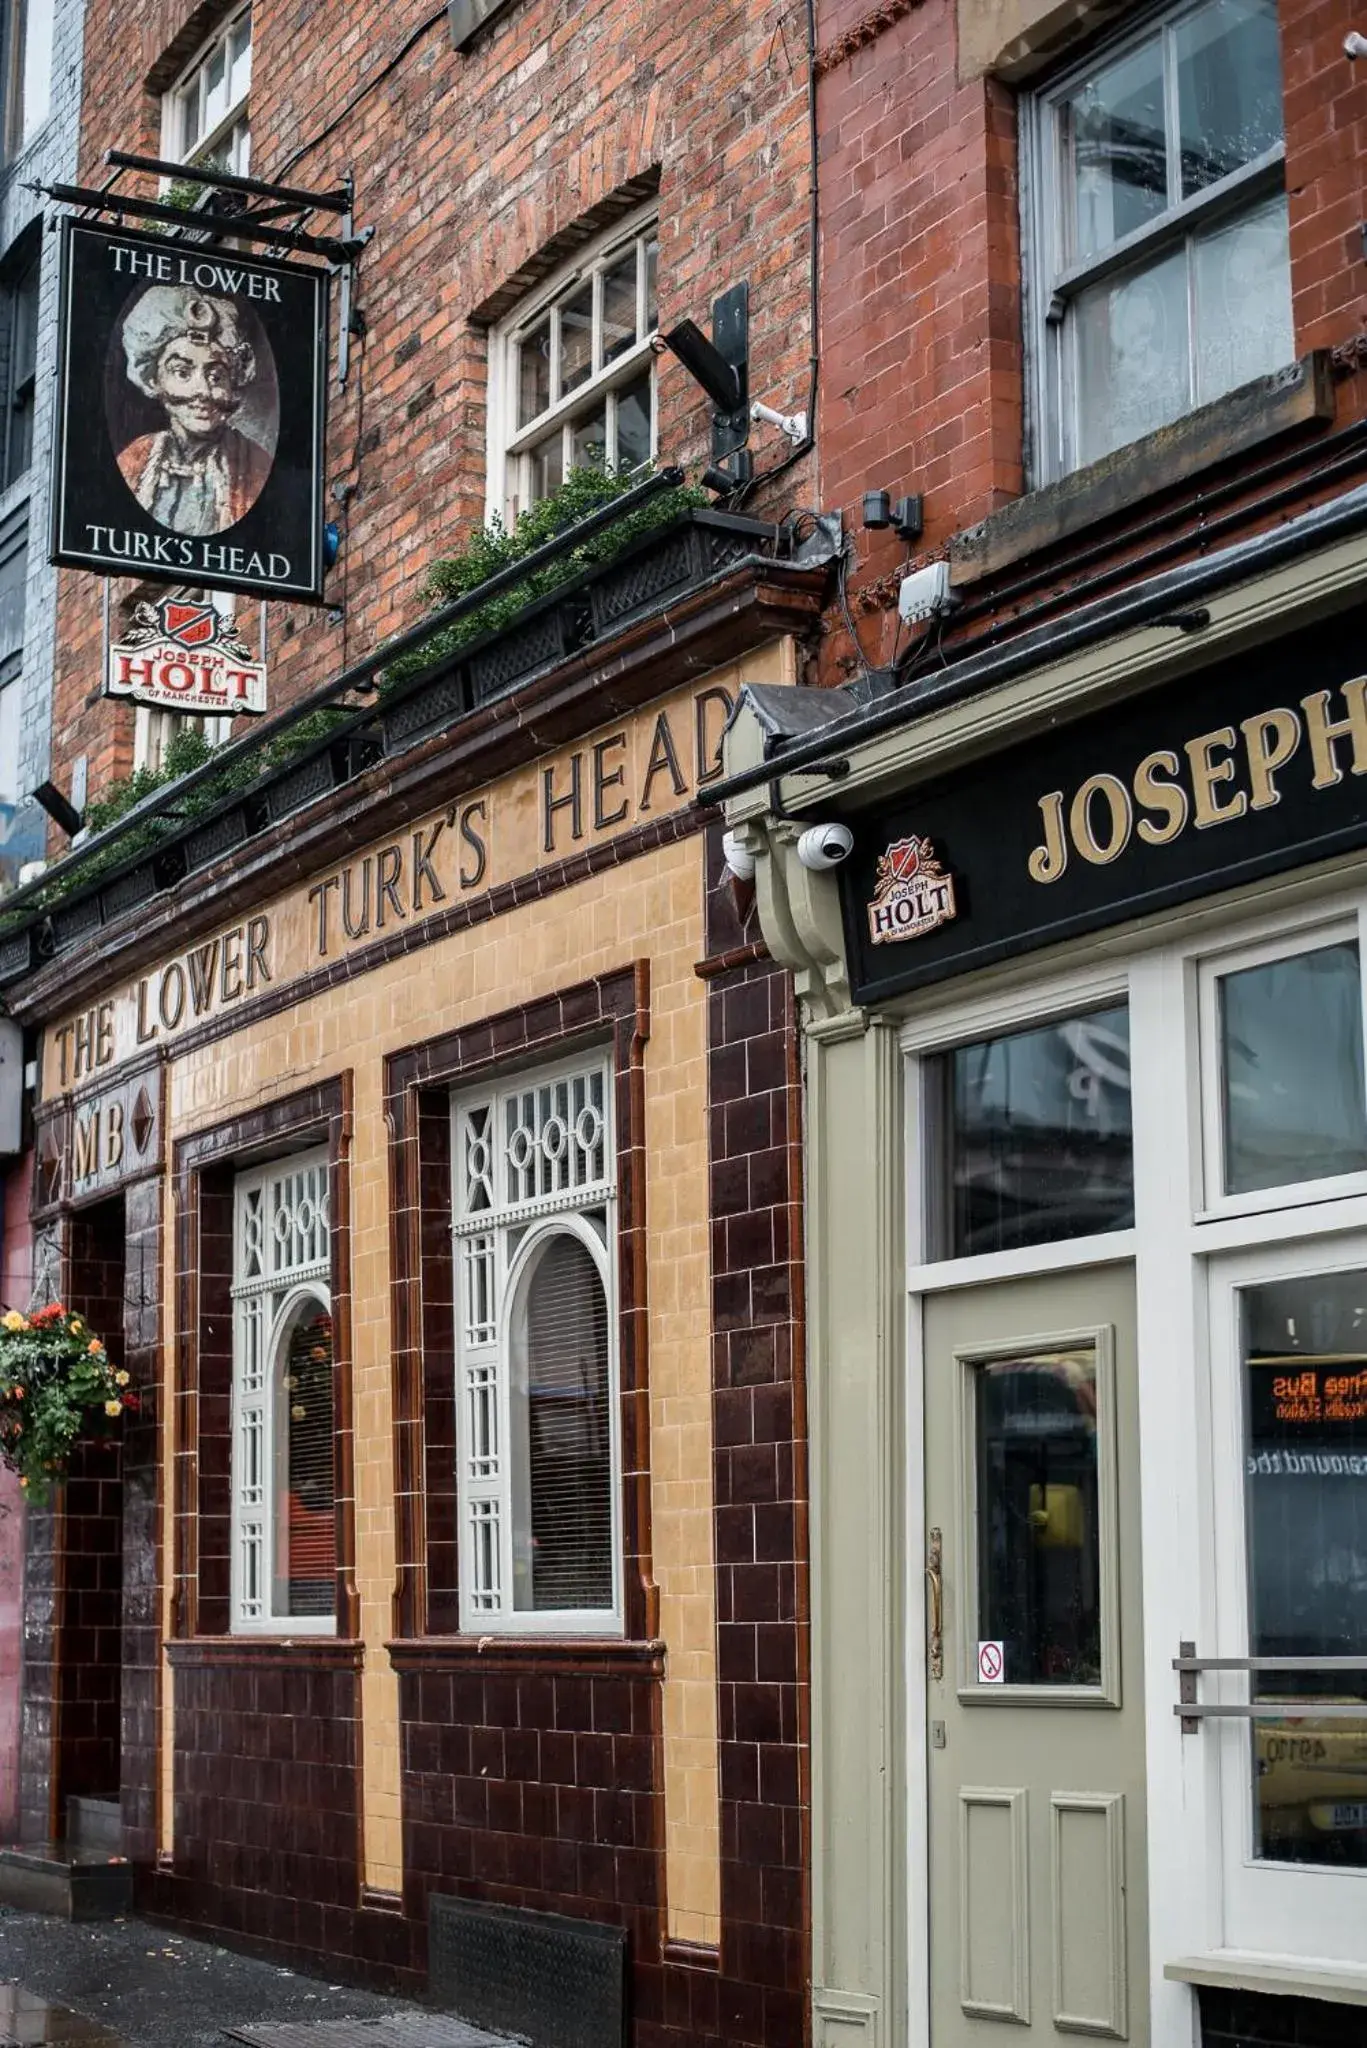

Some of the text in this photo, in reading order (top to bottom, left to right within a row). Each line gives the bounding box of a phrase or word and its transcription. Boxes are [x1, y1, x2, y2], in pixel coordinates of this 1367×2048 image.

[108, 245, 282, 303] THE LOWER
[85, 524, 291, 579] TURK'S HEAD
[118, 655, 258, 699] HOLT
[153, 647, 225, 669] JOSEPH
[148, 689, 229, 705] OF MANCHESTER
[1028, 675, 1367, 884] JOSEPH
[54, 686, 725, 1086] THE LOWER TURK'S HEAD
[874, 884, 949, 934] HOLT
[890, 880, 929, 902] JOSEPH
